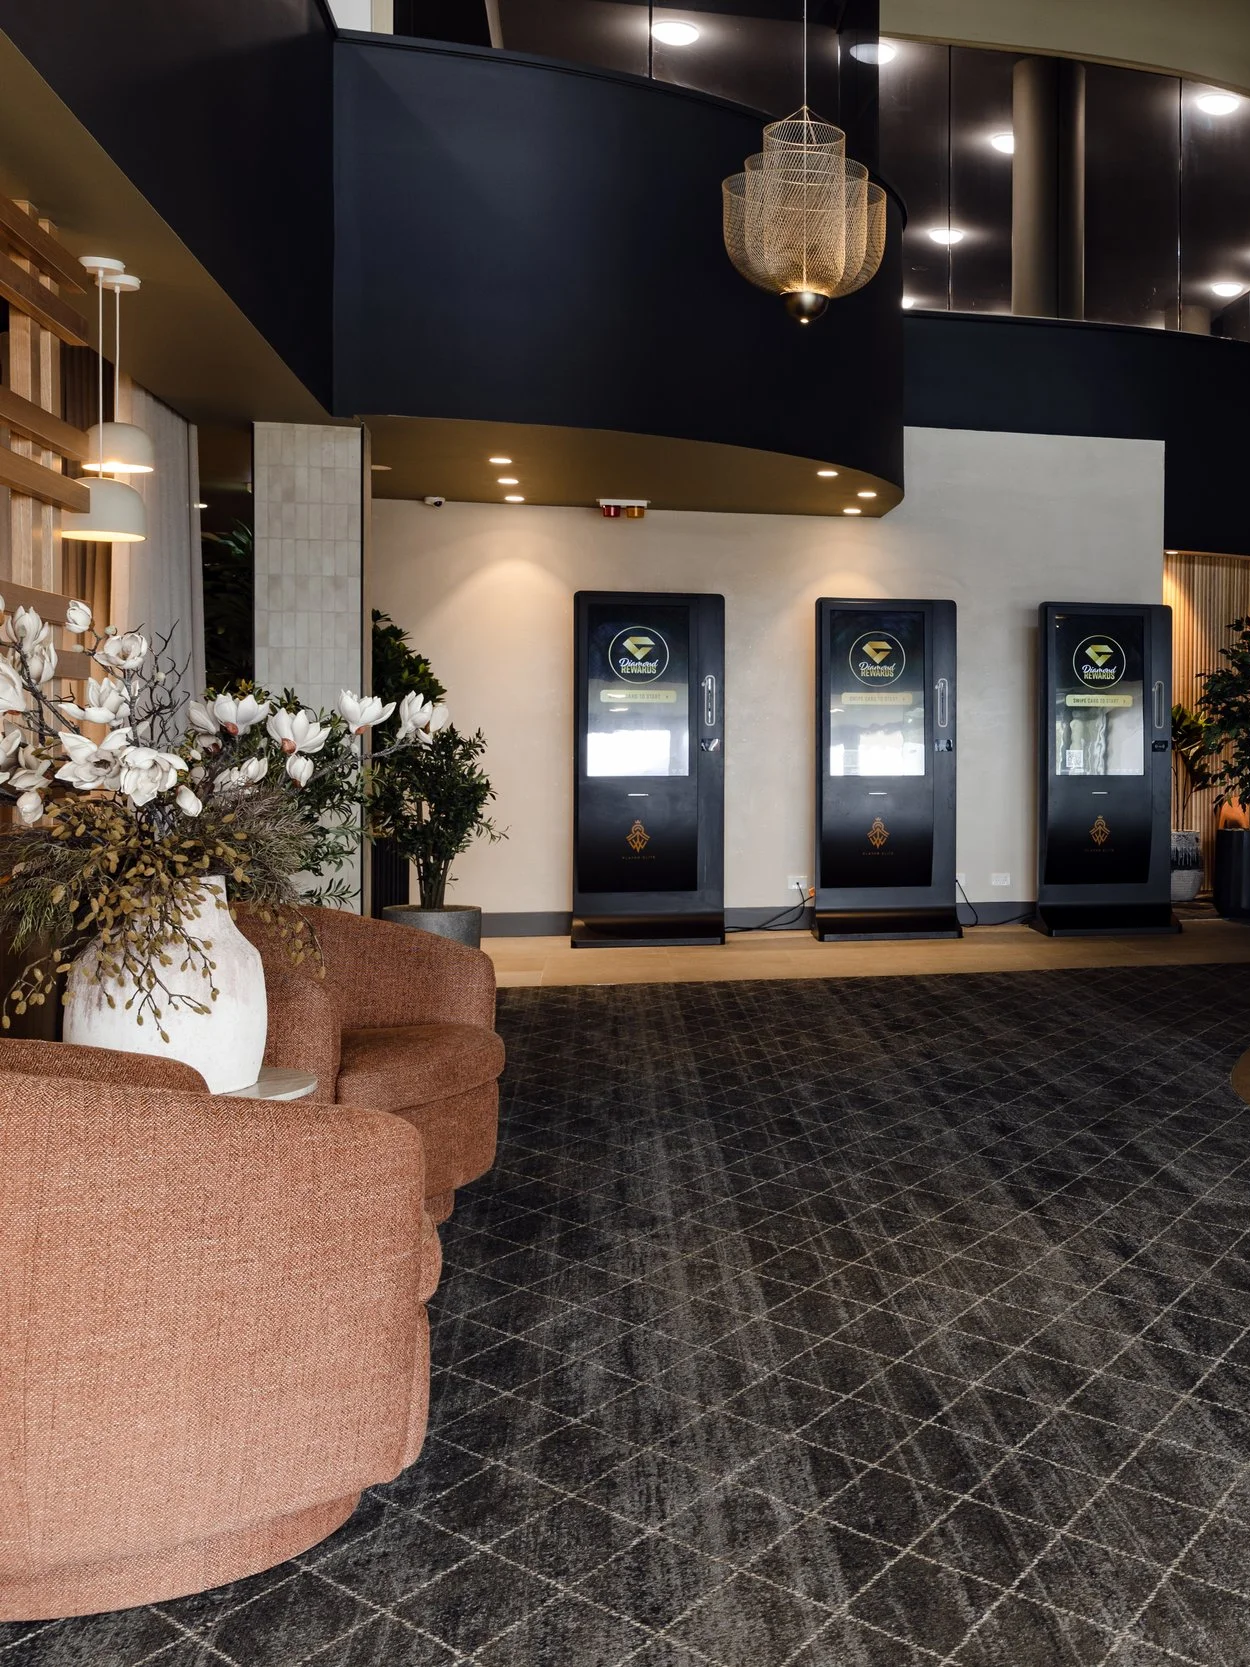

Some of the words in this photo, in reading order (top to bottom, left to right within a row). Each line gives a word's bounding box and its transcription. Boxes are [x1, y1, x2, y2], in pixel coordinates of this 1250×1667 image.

[619, 657, 659, 667] Diamond
[859, 661, 896, 671] Diamond
[621, 665, 657, 674] REWARDS
[861, 668, 894, 677] REWARDS
[1082, 664, 1117, 673] Diamond
[1084, 671, 1115, 680] REWARDS
